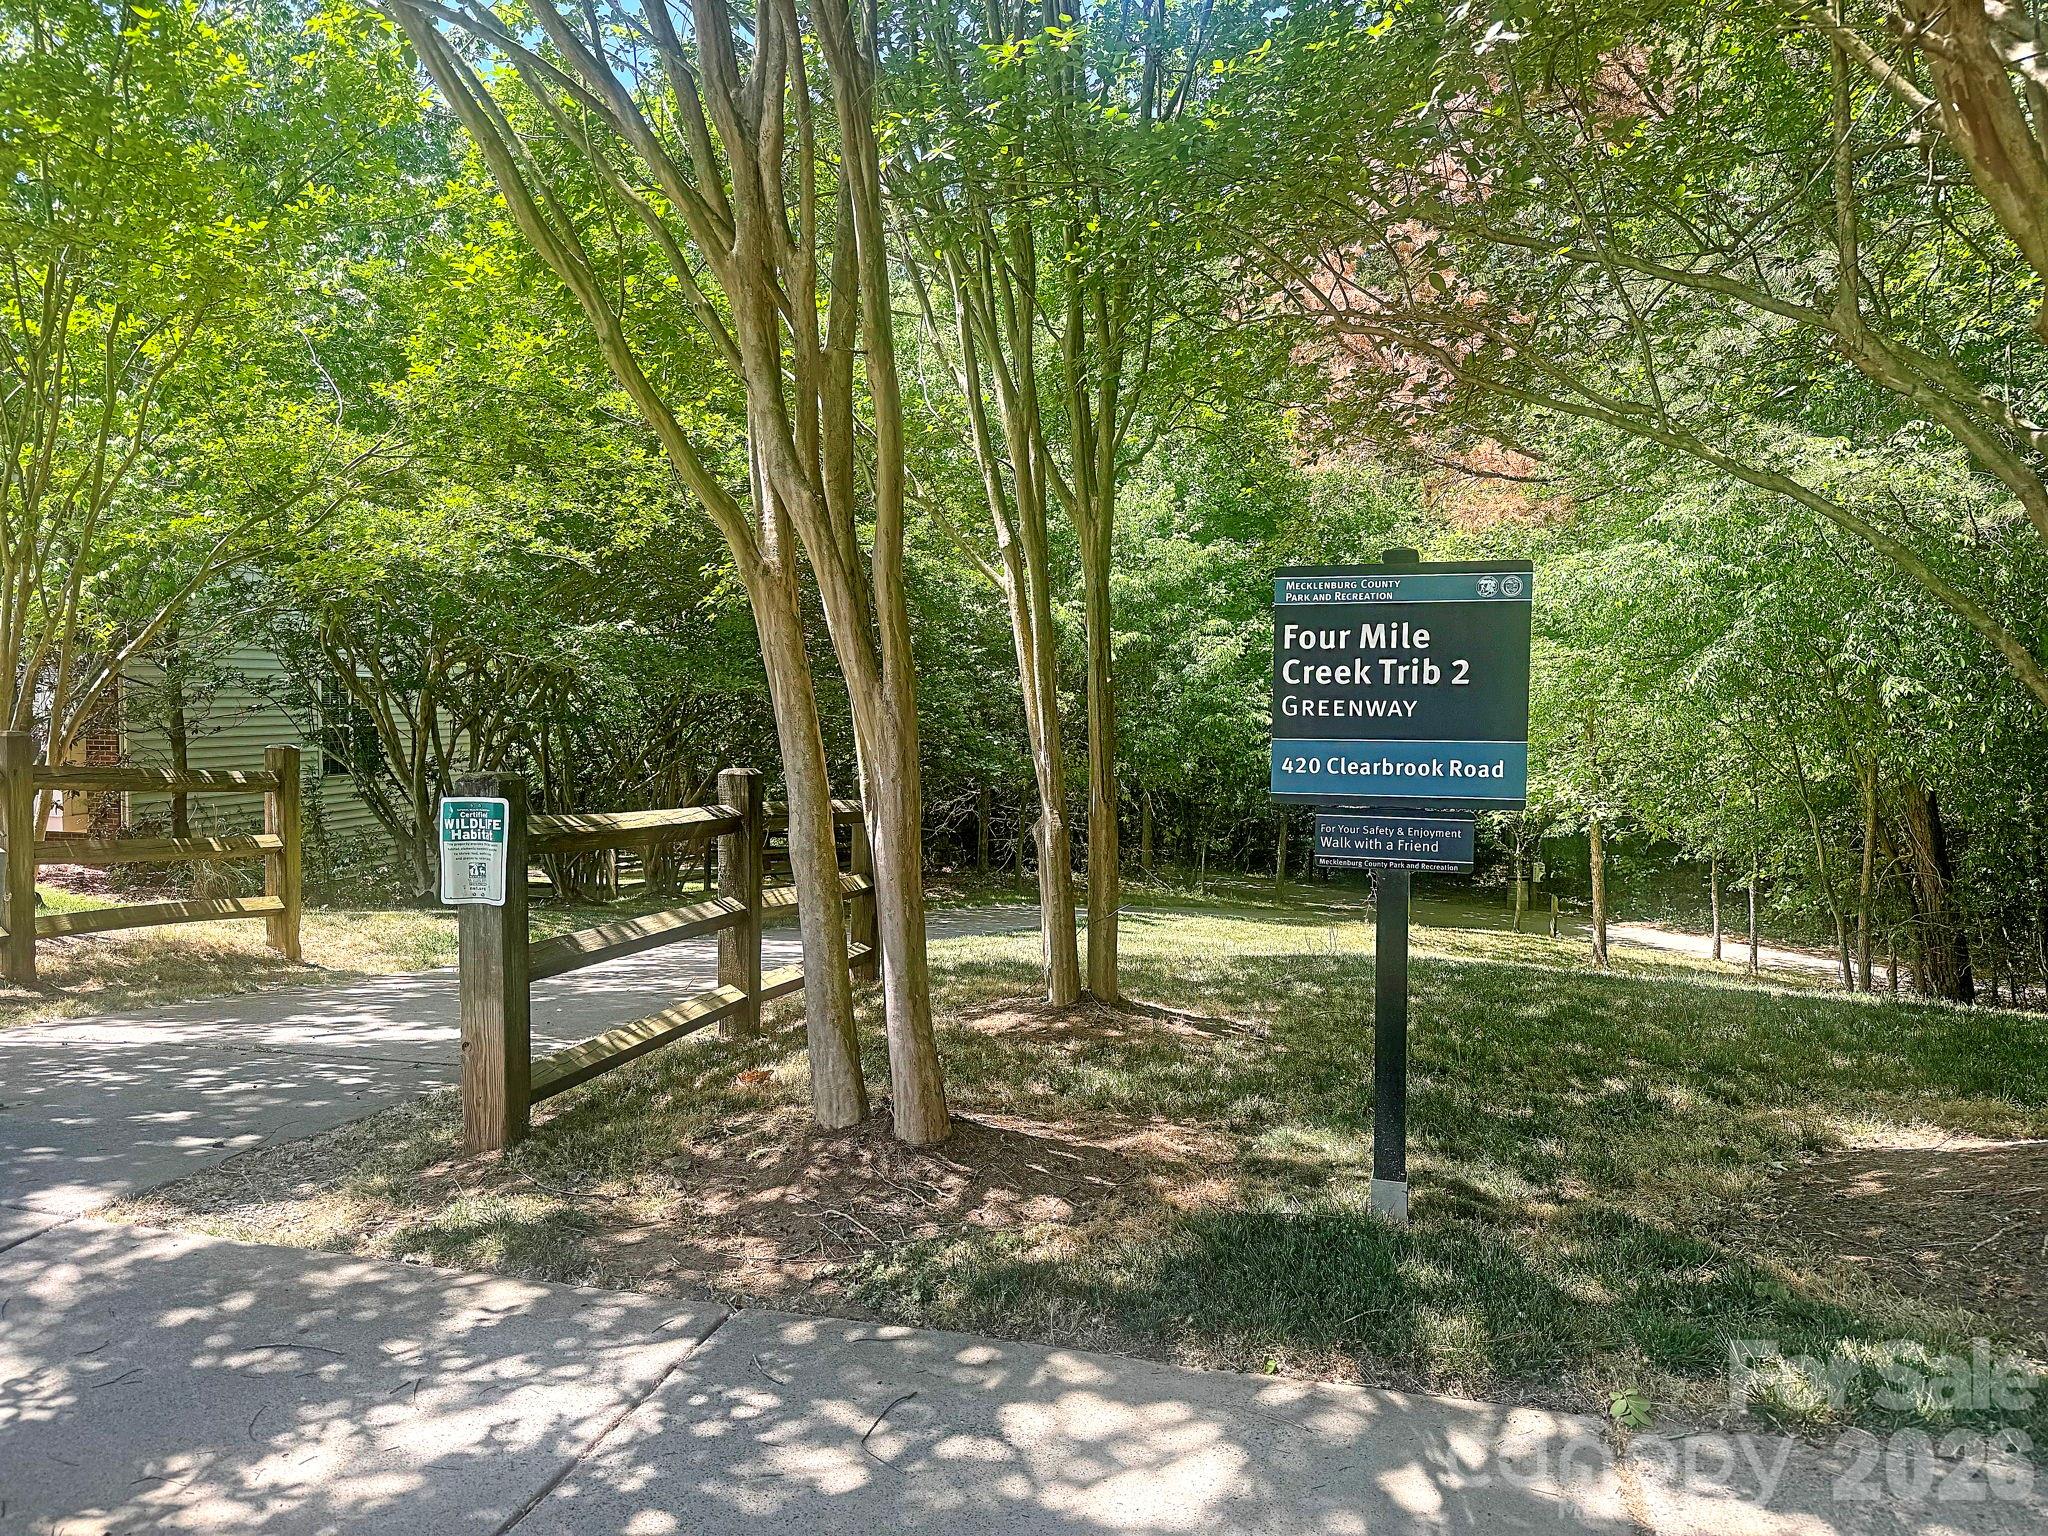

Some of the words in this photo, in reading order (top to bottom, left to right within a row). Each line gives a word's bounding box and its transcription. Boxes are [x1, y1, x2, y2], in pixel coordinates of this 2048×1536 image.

[1285, 580, 1357, 590] MECKLENBURG
[1360, 579, 1401, 589] COUNTY
[1285, 592, 1311, 602] PARK
[1312, 593, 1332, 601] AND
[1334, 591, 1393, 600] RECREATION
[1283, 624, 1351, 650] Four
[1359, 622, 1431, 649] Mile
[1282, 658, 1372, 685] Creek
[1378, 657, 1441, 685] Trib
[1451, 659, 1470, 685] 2
[1281, 695, 1418, 717] GREENWAY
[1281, 757, 1321, 774] 420
[1326, 757, 1444, 777] Clearbrook
[1449, 759, 1504, 778] Road
[444, 819, 502, 831] WILDLIFE
[1320, 823, 1336, 833] For
[1337, 824, 1360, 835] Your
[1362, 825, 1395, 838] Safety
[1396, 827, 1405, 837] &
[1407, 827, 1463, 839] Enjoyment
[451, 829, 493, 841] Habitat
[1320, 836, 1351, 849] Walk
[1354, 838, 1382, 850] with
[1386, 841, 1394, 851] a
[1398, 840, 1440, 853] Friend
[1319, 858, 1363, 868] Mecklenburg
[1364, 860, 1389, 869] County
[1389, 861, 1406, 869] Park
[1421, 864, 1459, 872] Recreation
